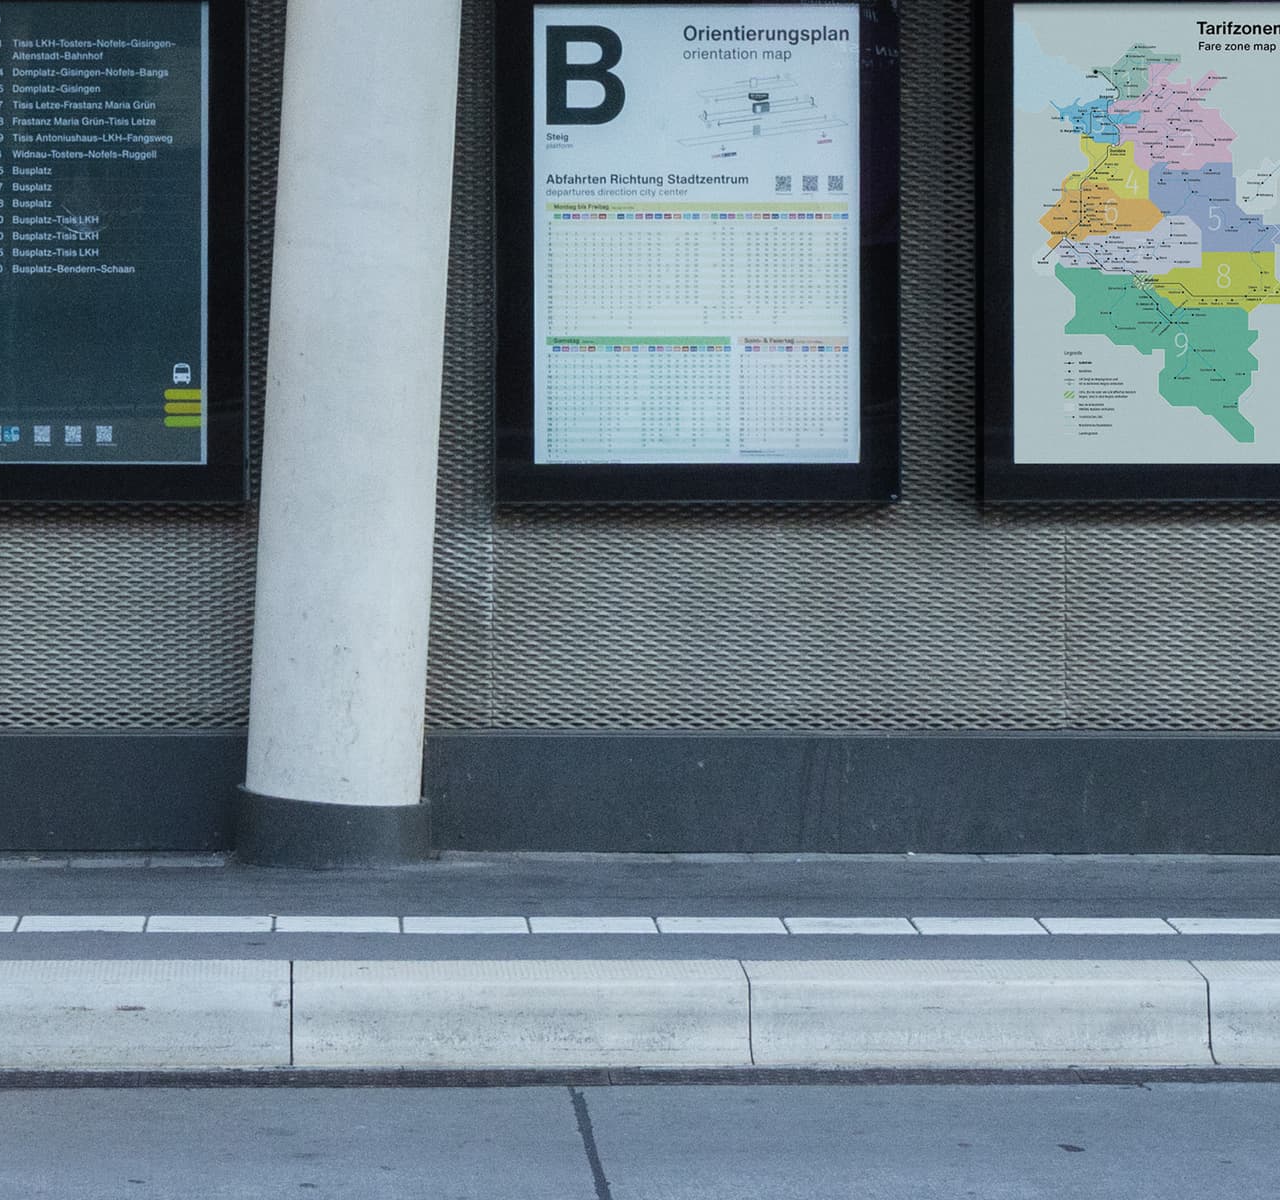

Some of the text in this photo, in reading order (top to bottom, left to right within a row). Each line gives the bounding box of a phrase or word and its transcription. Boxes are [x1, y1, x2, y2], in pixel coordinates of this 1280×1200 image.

[683, 25, 850, 46] Orientierungsplan
[13, 39, 34, 48] Tisis
[1198, 42, 1277, 53] Fare zone map
[682, 48, 792, 63] orientation map
[545, 25, 626, 125] B
[13, 101, 33, 110] Tisis
[36, 101, 102, 110] Letze-Frastanz
[105, 101, 130, 110] Maria
[132, 101, 155, 110] Grün
[13, 117, 51, 126] Frastanz
[54, 117, 79, 126] Maria
[132, 117, 156, 126] Letze
[13, 134, 33, 143] Tisis
[546, 133, 569, 143] Steig
[13, 166, 51, 177] Busplatz
[546, 174, 749, 187] Abfahrten Richtung Stadtzentrum
[1125, 170, 1139, 195] 4
[13, 183, 52, 194] Busplatz
[545, 189, 596, 199] departures
[639, 189, 657, 199] city
[13, 199, 51, 210] Busplatz
[79, 216, 99, 225] LKH
[1208, 206, 1221, 231] 5
[79, 232, 99, 241] LKH
[79, 249, 99, 258] LKH
[1216, 263, 1232, 289] 8
[1174, 332, 1189, 358] 9
